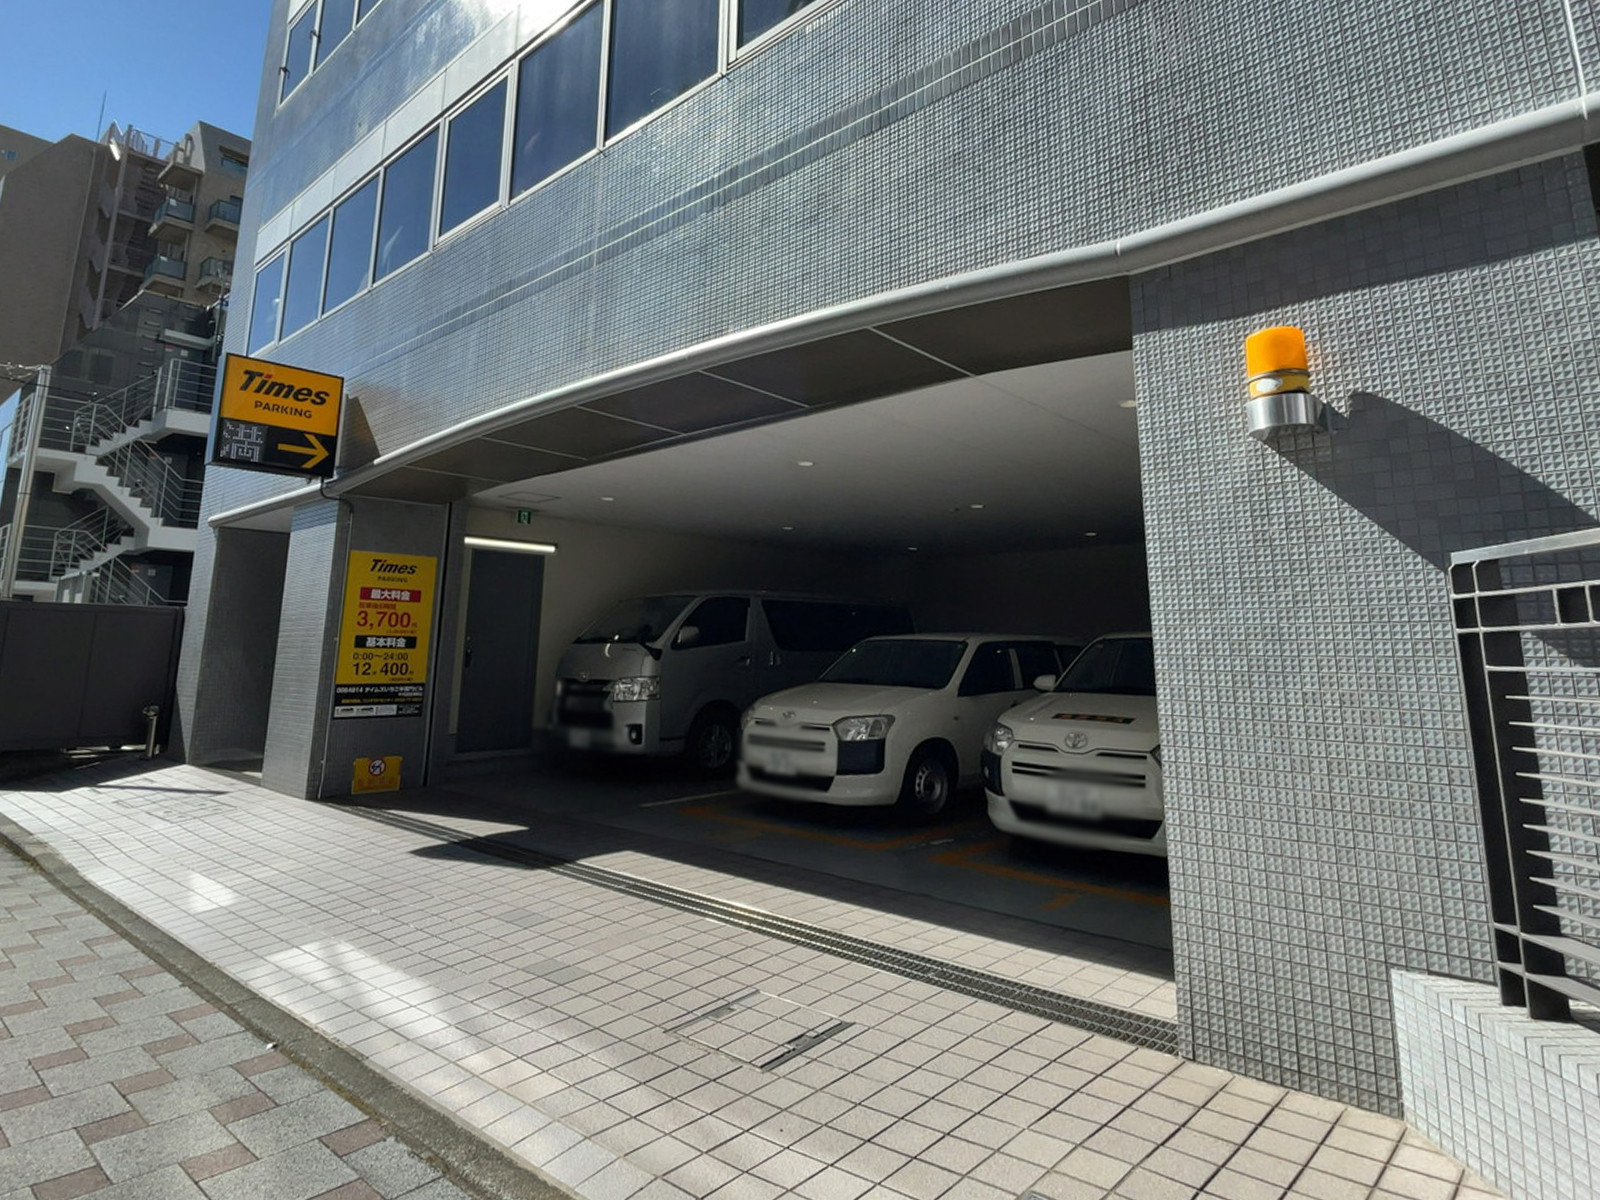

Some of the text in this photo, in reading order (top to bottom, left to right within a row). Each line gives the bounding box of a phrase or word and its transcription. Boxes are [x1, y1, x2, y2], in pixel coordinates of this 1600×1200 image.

[240, 369, 330, 406] Times
[254, 401, 312, 419] PARKING
[220, 422, 263, 463] 満
[370, 558, 418, 575] Times
[370, 588, 410, 601] 最大料金
[365, 637, 407, 648] 基本料金
